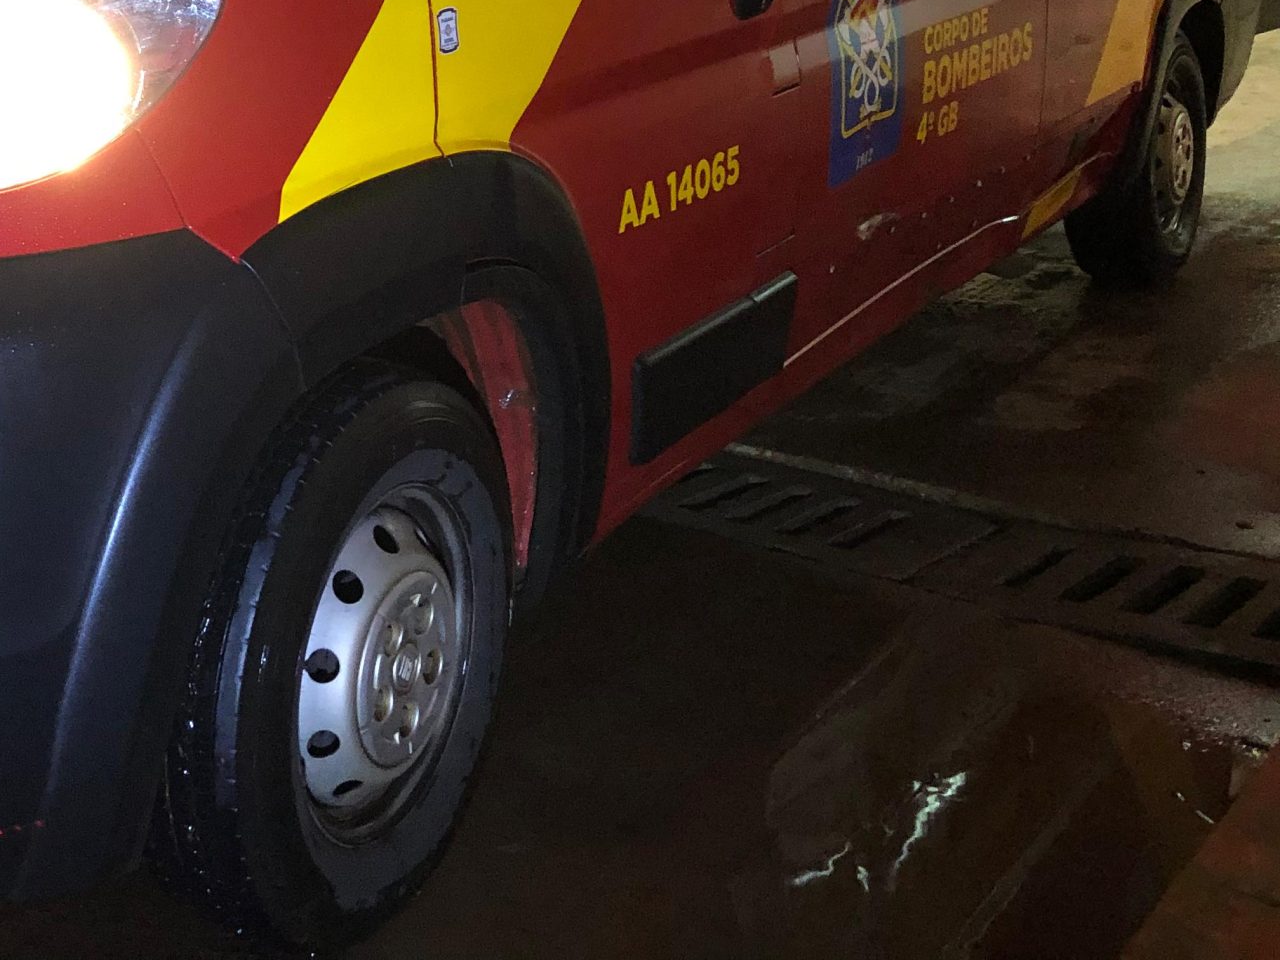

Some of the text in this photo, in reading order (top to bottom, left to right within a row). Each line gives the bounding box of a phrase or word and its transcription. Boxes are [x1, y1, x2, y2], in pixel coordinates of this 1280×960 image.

[922, 22, 1033, 105] BOMBEIROS
[924, 7, 989, 55] CORPO DE
[937, 101, 959, 137] GB
[618, 144, 740, 234] AA 14065
